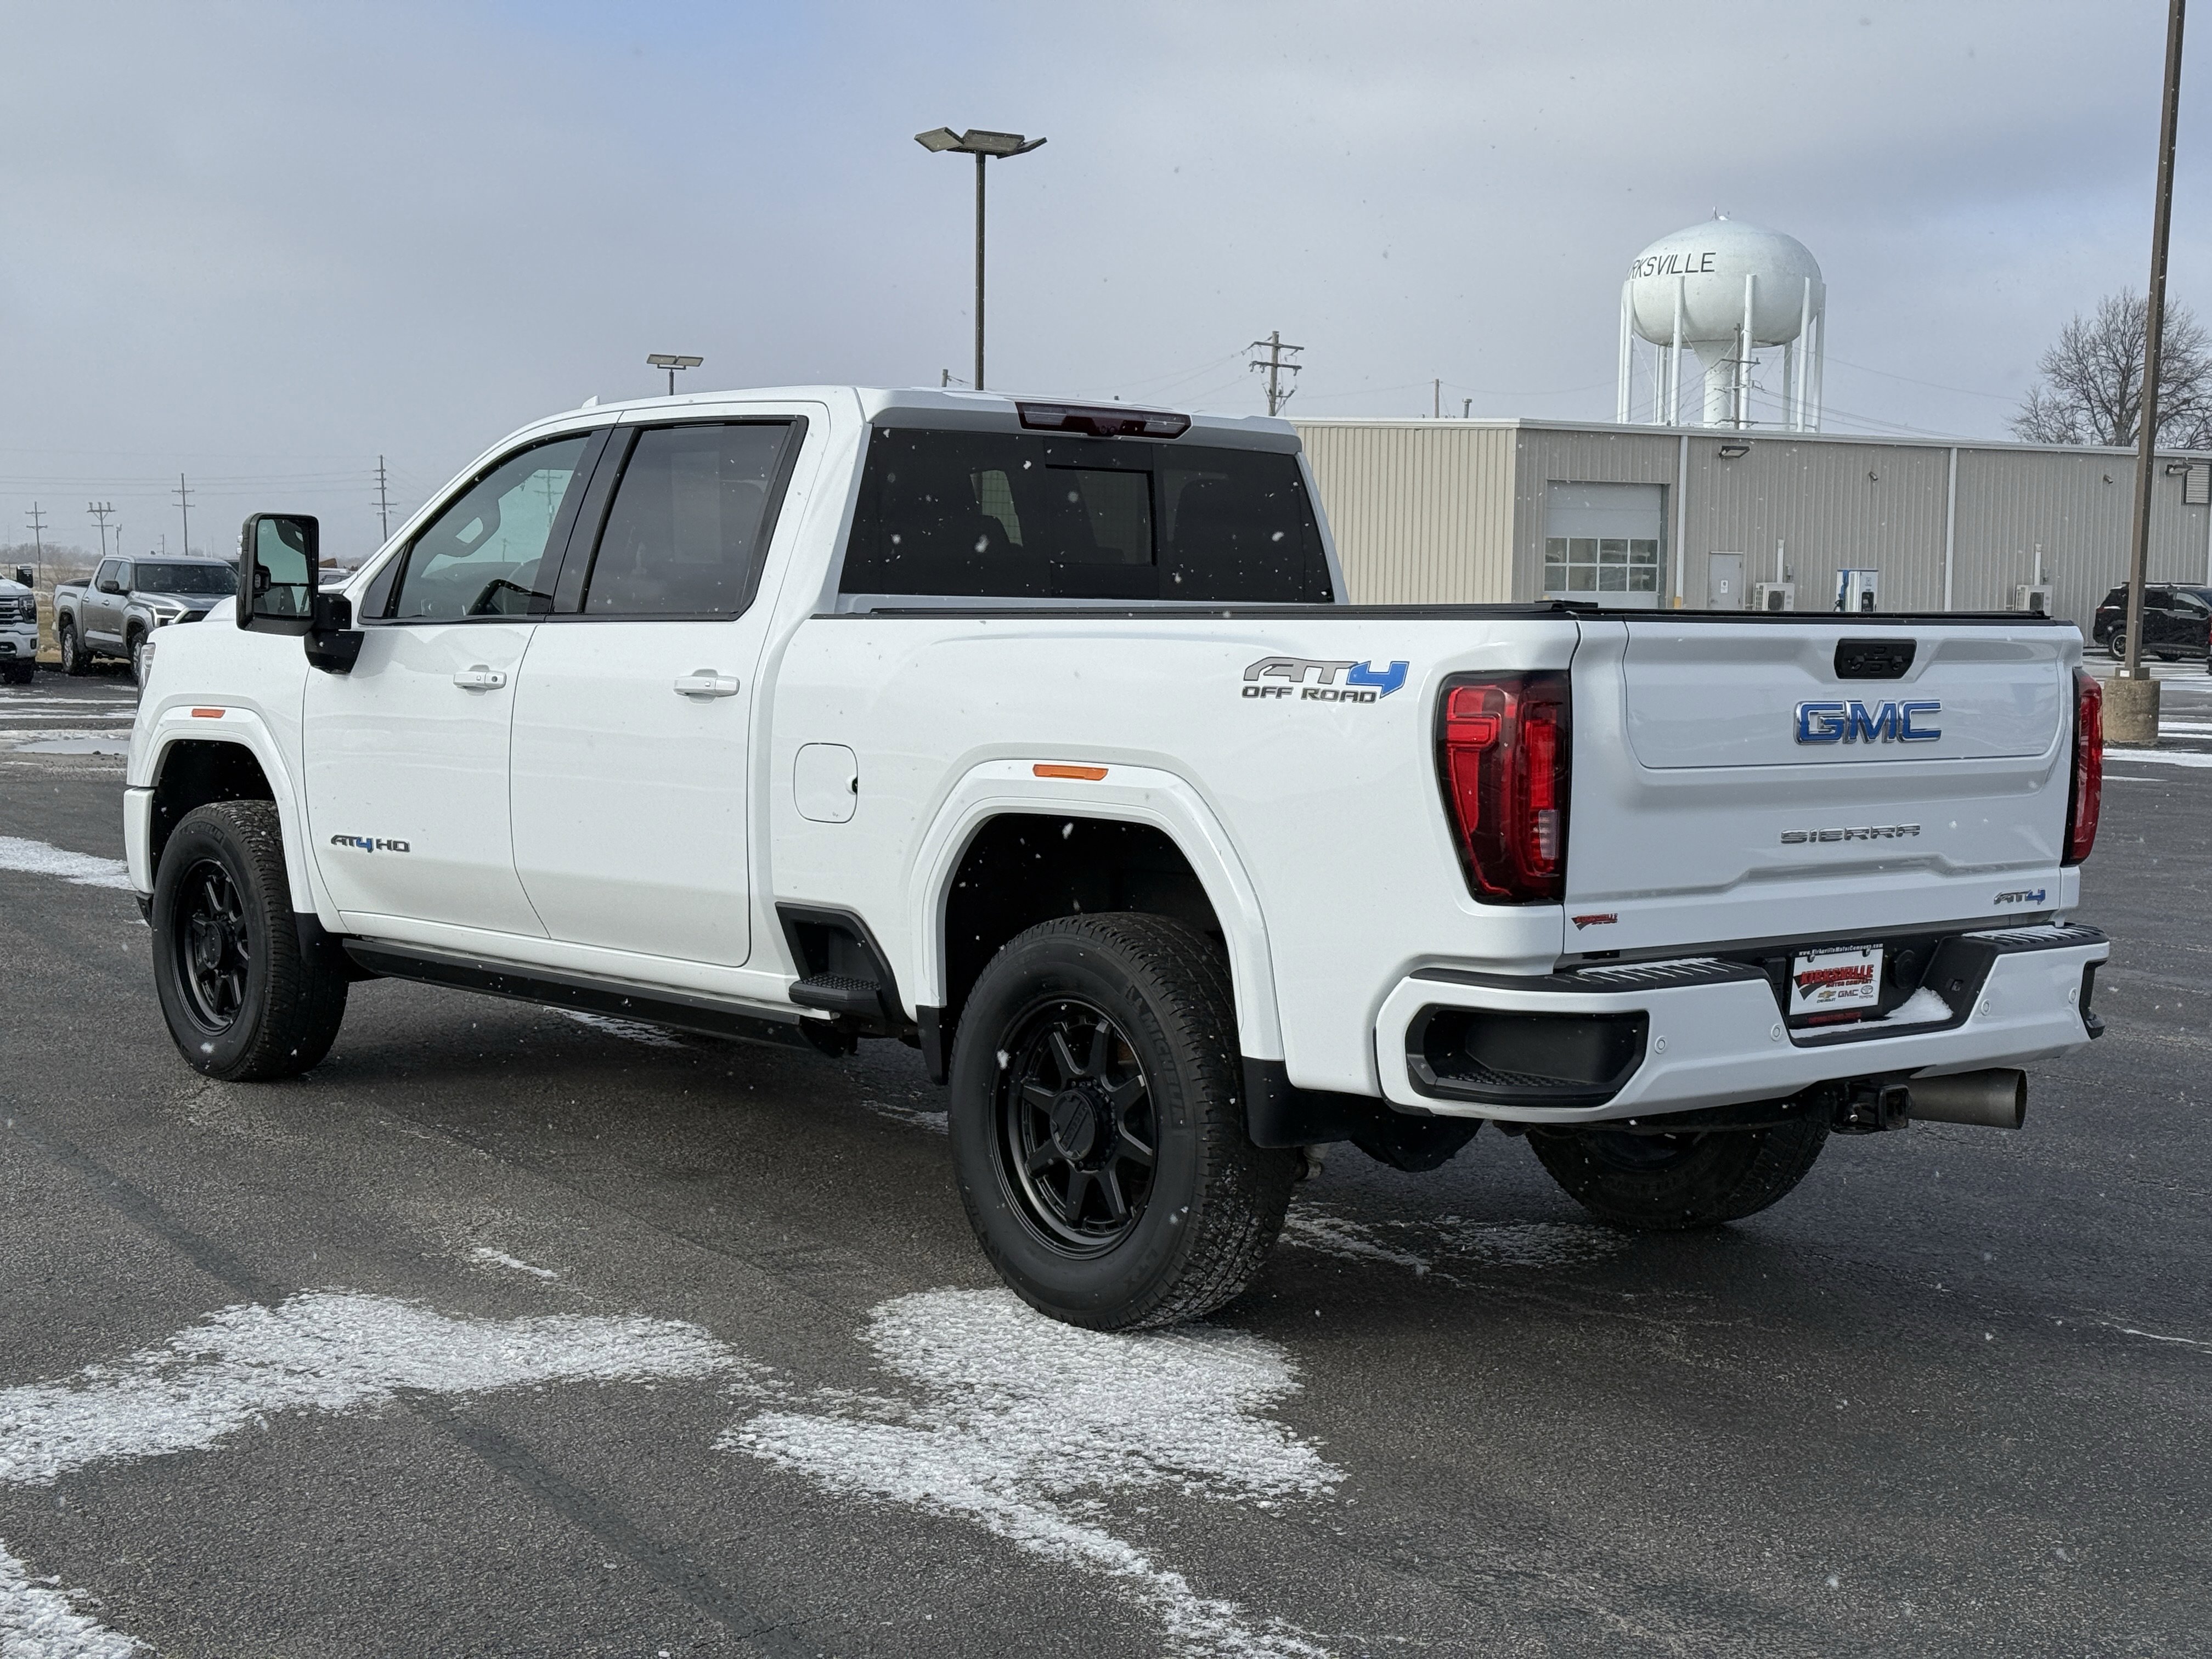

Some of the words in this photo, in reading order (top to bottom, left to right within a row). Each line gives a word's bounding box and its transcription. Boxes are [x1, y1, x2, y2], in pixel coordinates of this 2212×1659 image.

[1243, 657, 1410, 699] AT4
[1242, 686, 1294, 699] OFF
[1301, 687, 1378, 704] ROAD
[1793, 699, 1942, 745] GMC
[1780, 823, 1921, 844] SIERRA
[1994, 888, 2046, 905] AT4
[1800, 964, 1875, 985] KIRKSVILLE
[1838, 989, 1859, 998] GMC
